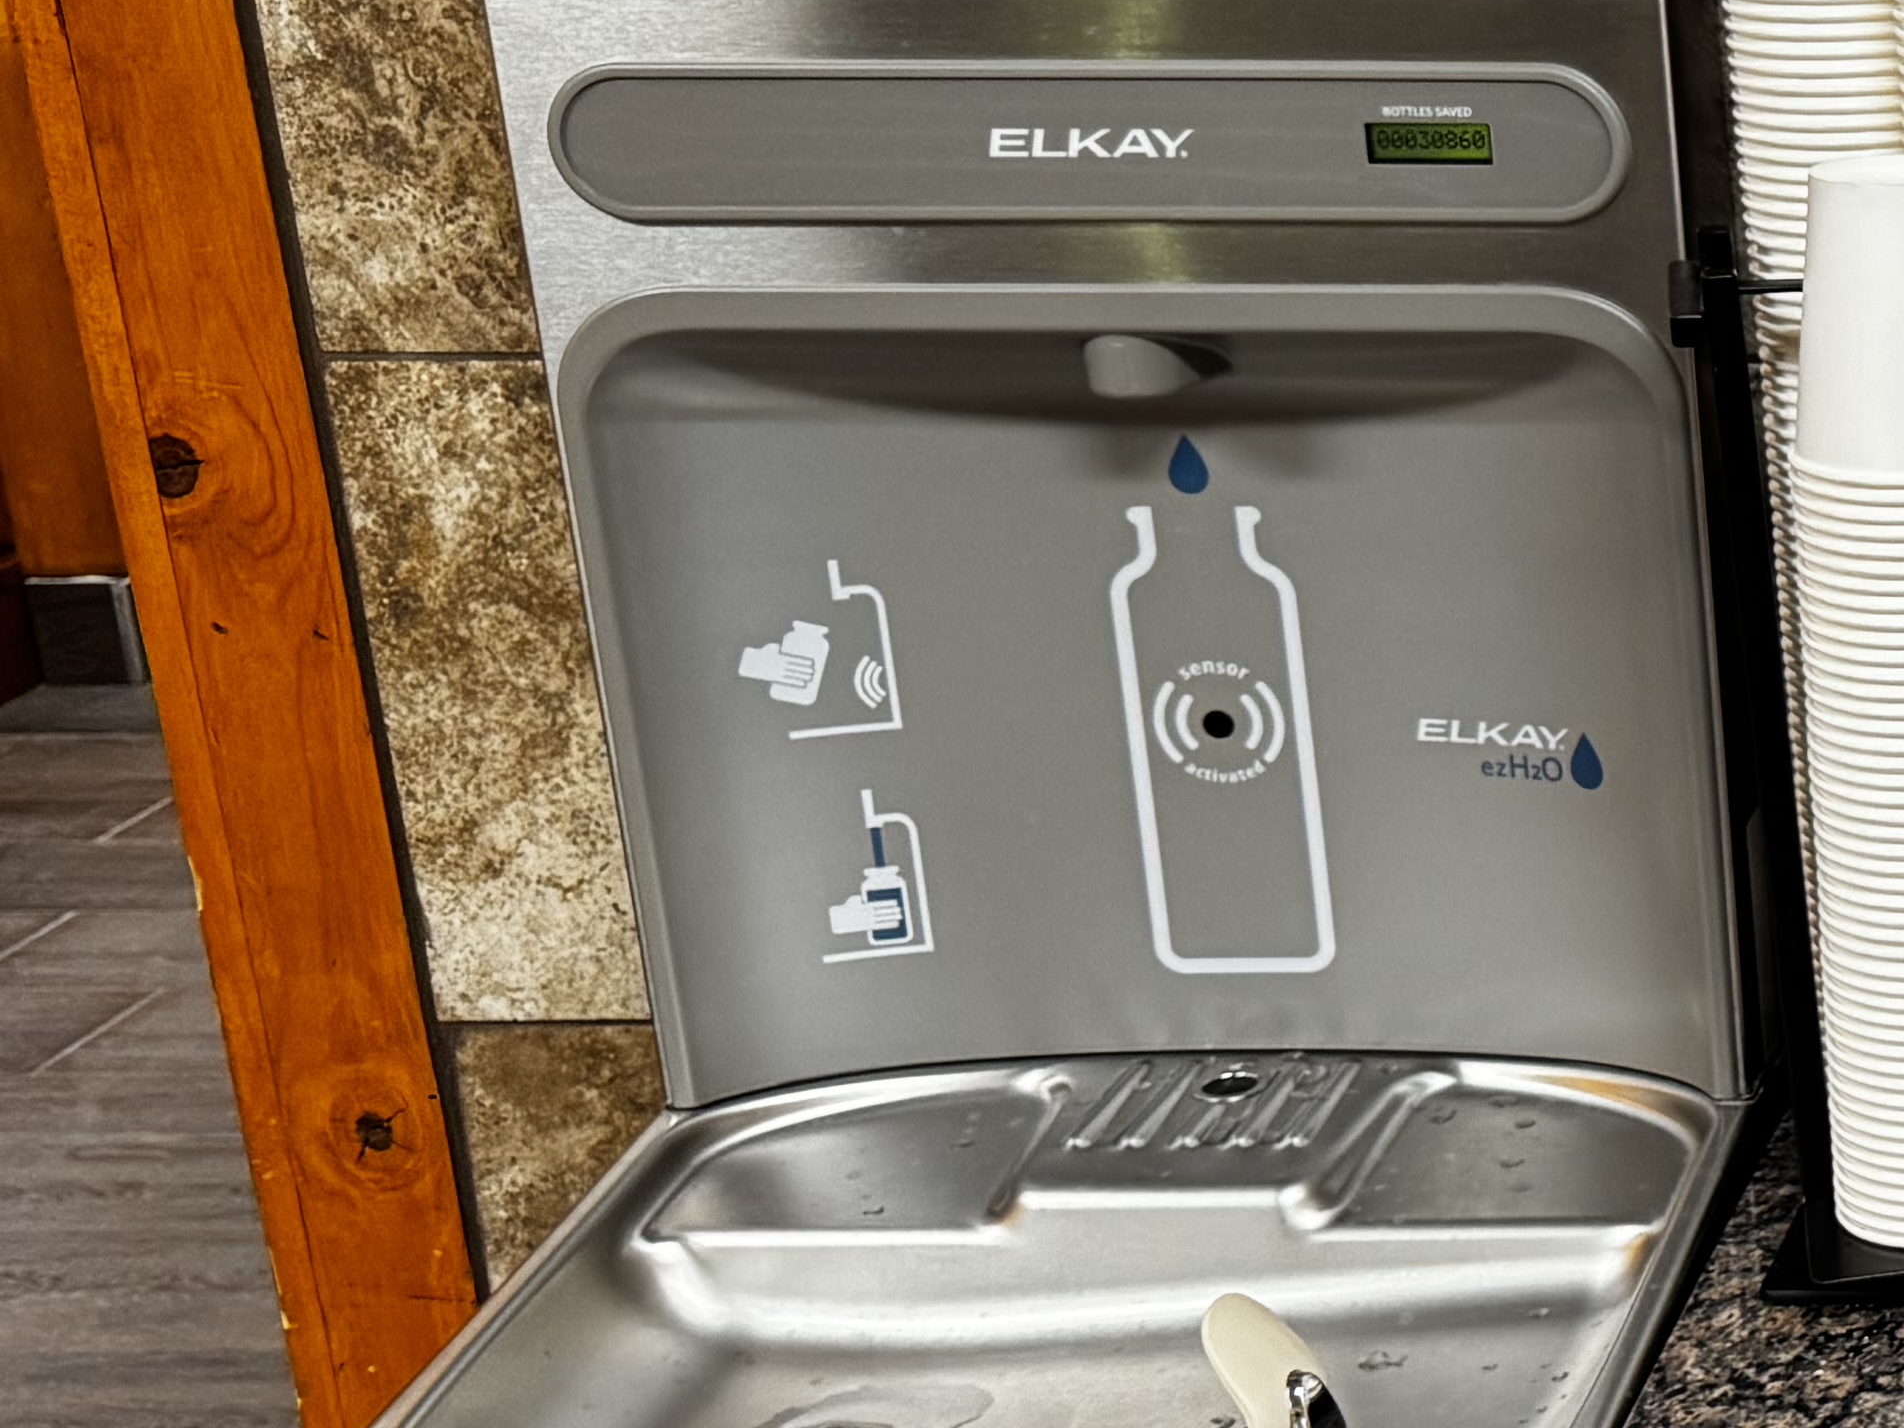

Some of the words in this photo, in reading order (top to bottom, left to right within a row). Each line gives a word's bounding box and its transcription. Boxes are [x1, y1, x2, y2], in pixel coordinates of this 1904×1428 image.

[1382, 106, 1433, 117] BOTTLES
[1435, 106, 1473, 117] SAVED
[1178, 660, 1250, 681] sensor
[1184, 759, 1266, 783] activated
